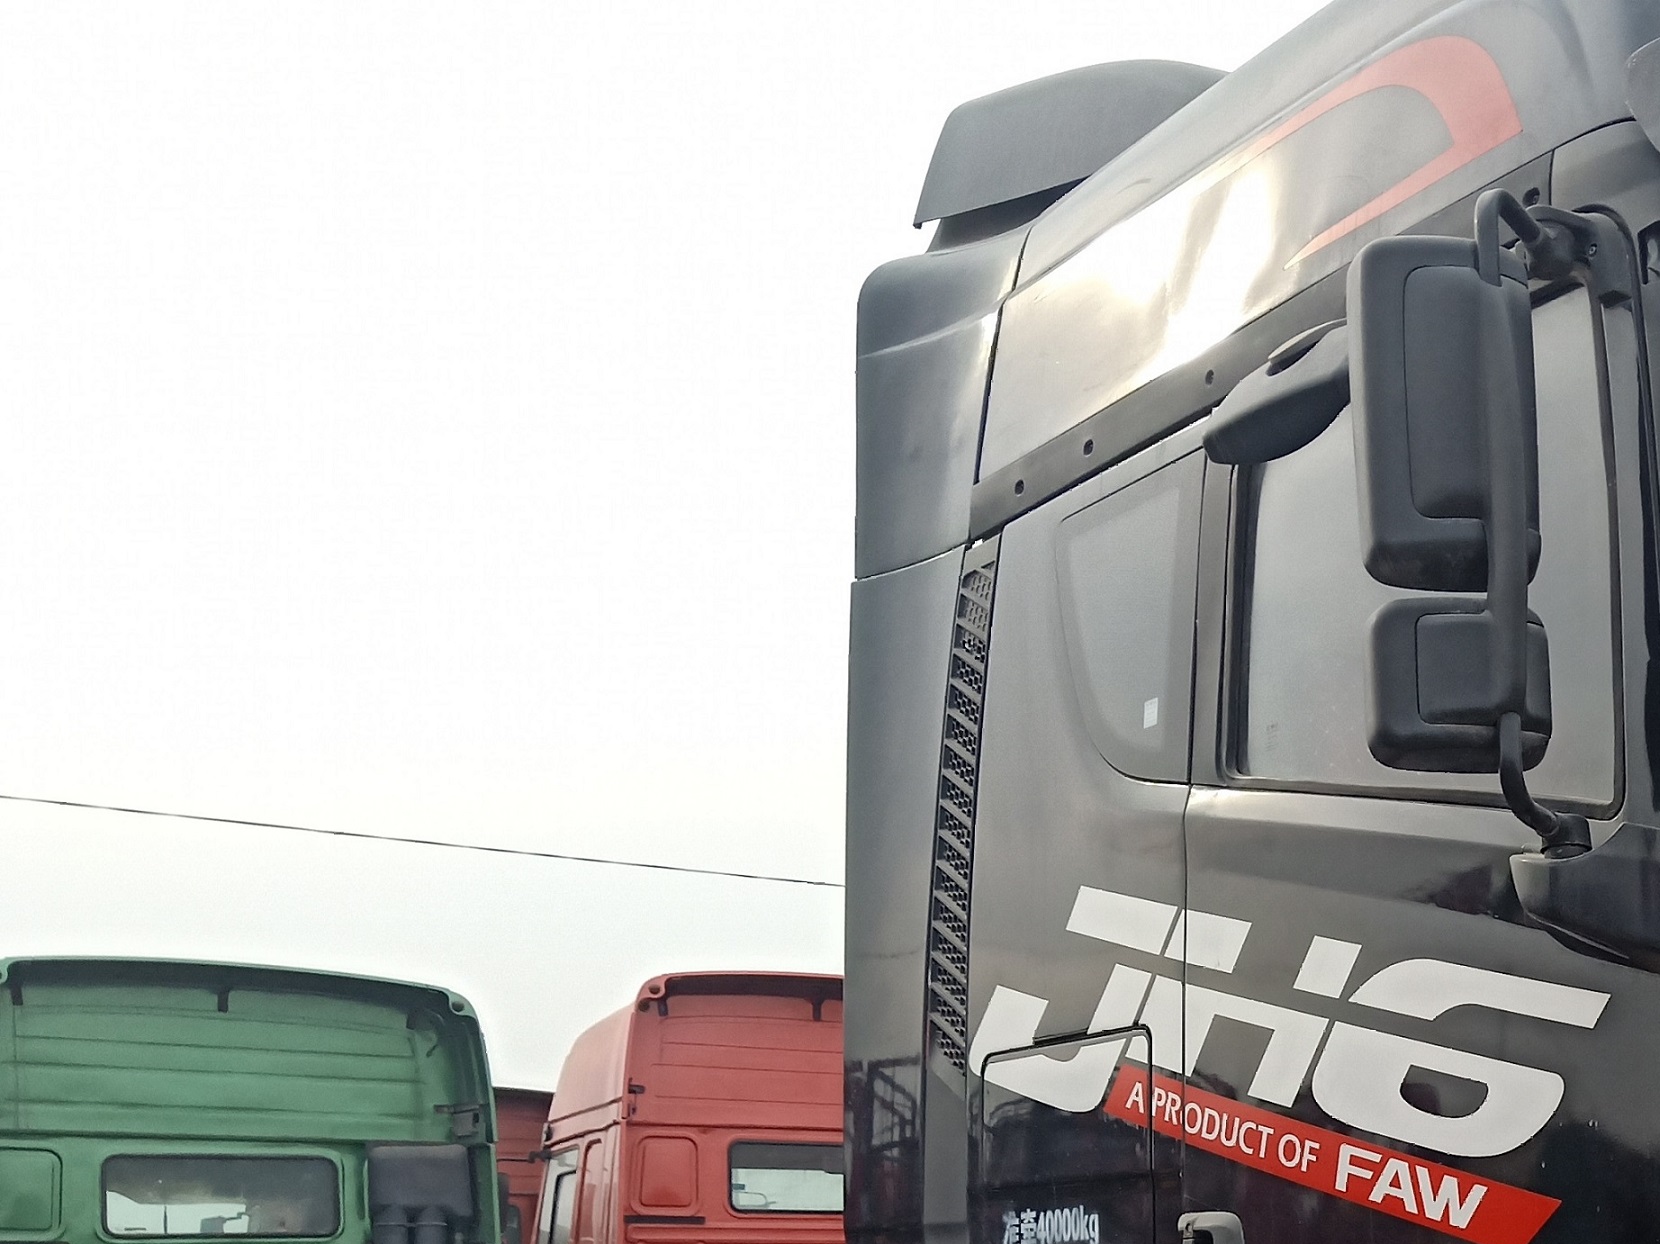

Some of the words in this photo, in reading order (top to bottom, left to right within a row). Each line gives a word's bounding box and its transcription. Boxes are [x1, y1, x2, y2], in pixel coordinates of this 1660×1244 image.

[1125, 1081, 1145, 1114] A
[1151, 1083, 1276, 1161] PRODUCT
[1278, 1133, 1320, 1173] OF
[1334, 1143, 1488, 1230] FAW
